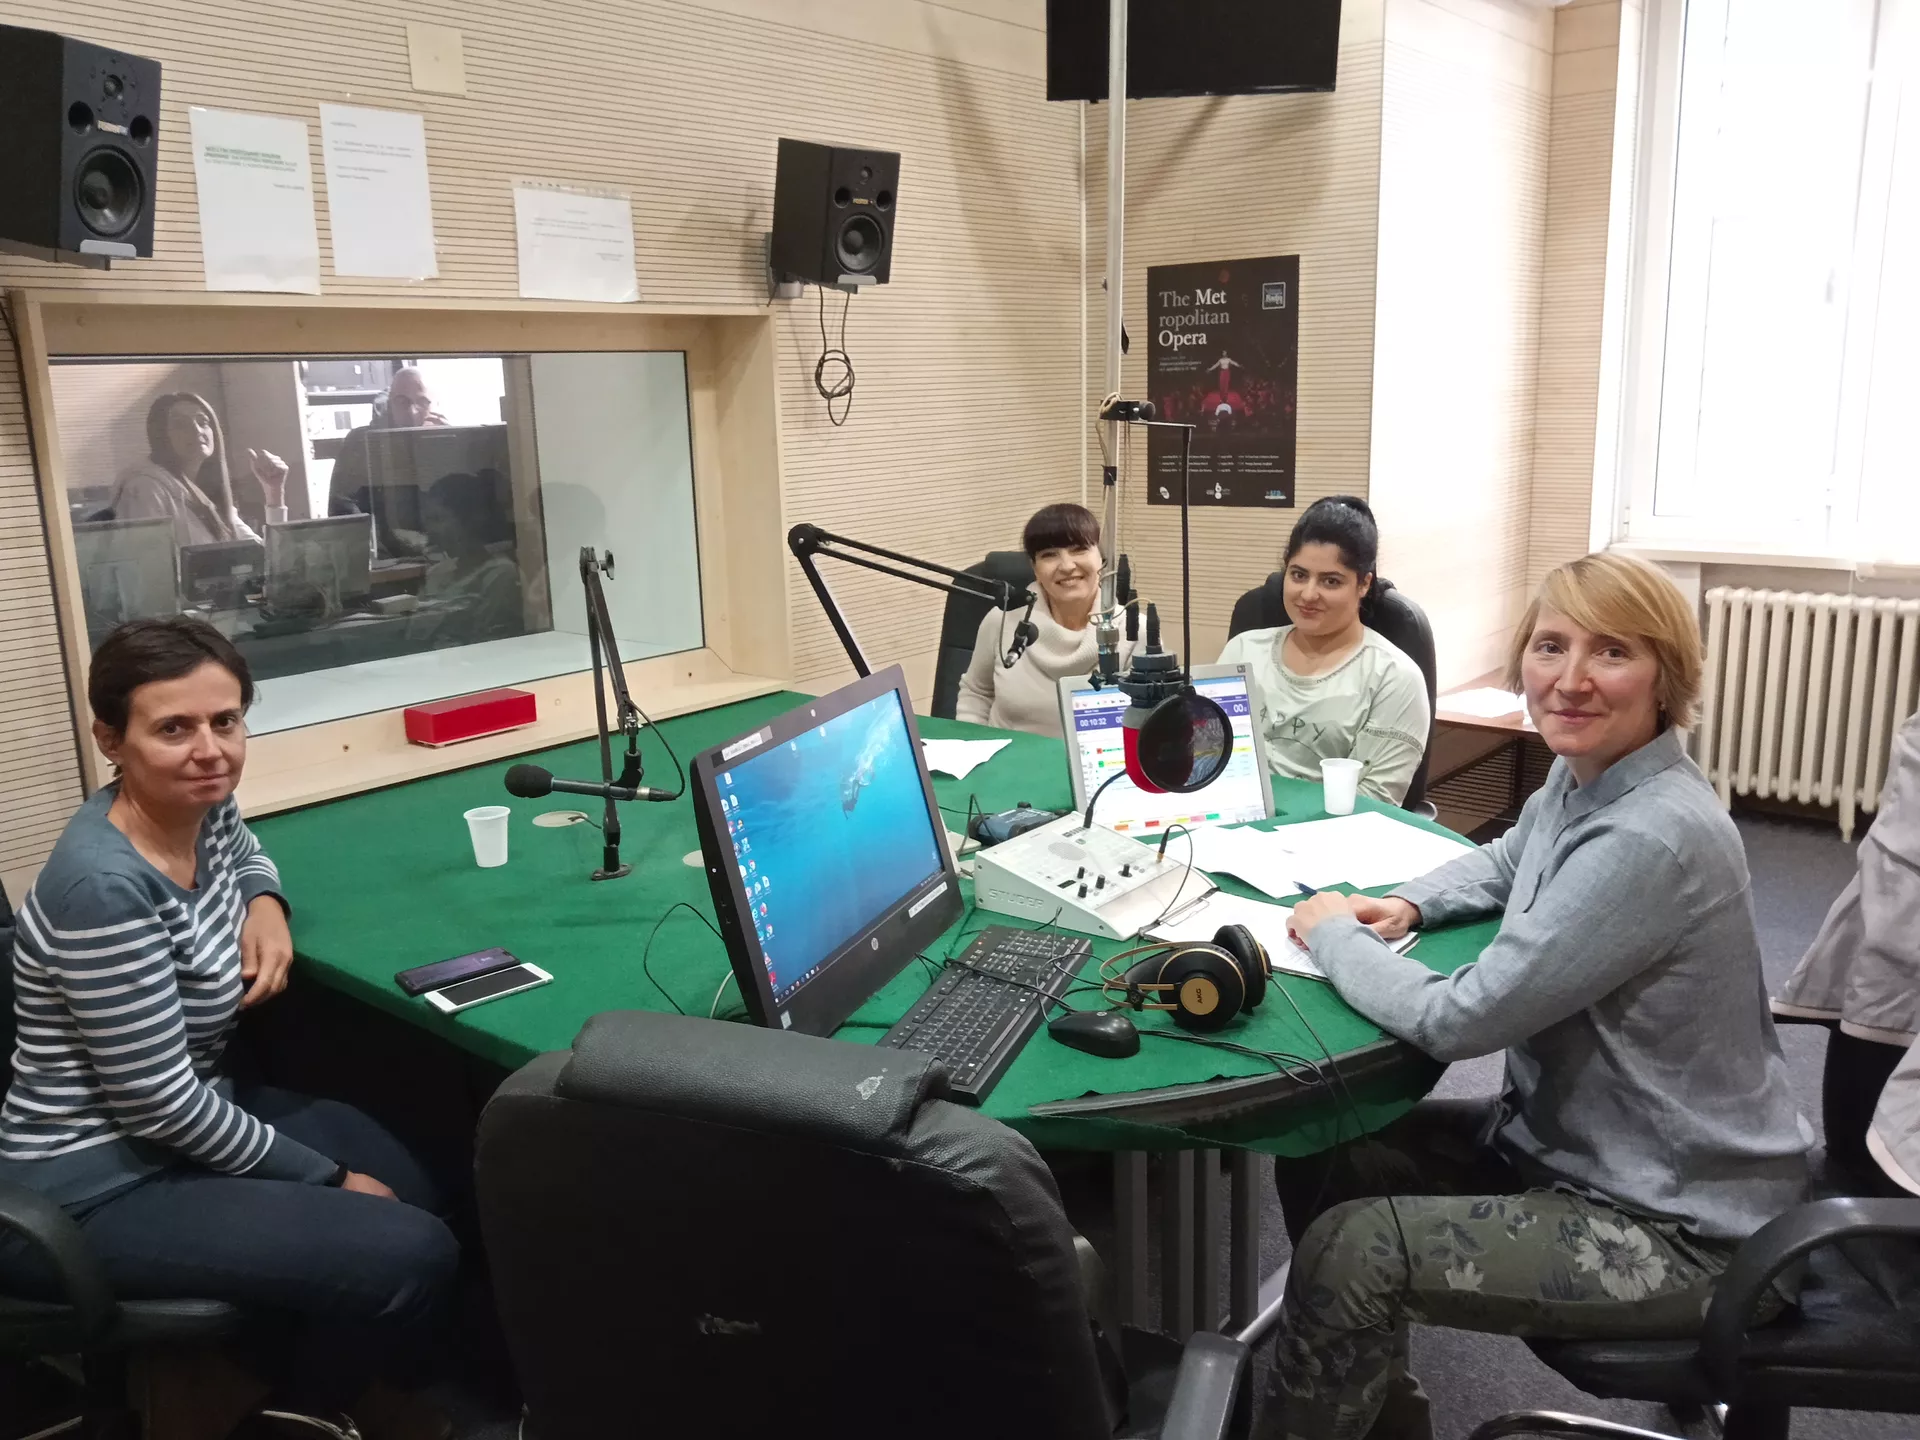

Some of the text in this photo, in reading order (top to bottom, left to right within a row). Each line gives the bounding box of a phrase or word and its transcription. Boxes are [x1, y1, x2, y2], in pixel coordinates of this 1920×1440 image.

[1159, 288, 1227, 308] The Met
[1159, 308, 1230, 331] ropolitan
[1158, 329, 1207, 351] Opera
[1079, 717, 1107, 727] 00:10:32
[988, 887, 1045, 911] STUDER
[1195, 987, 1203, 1004] AKG
